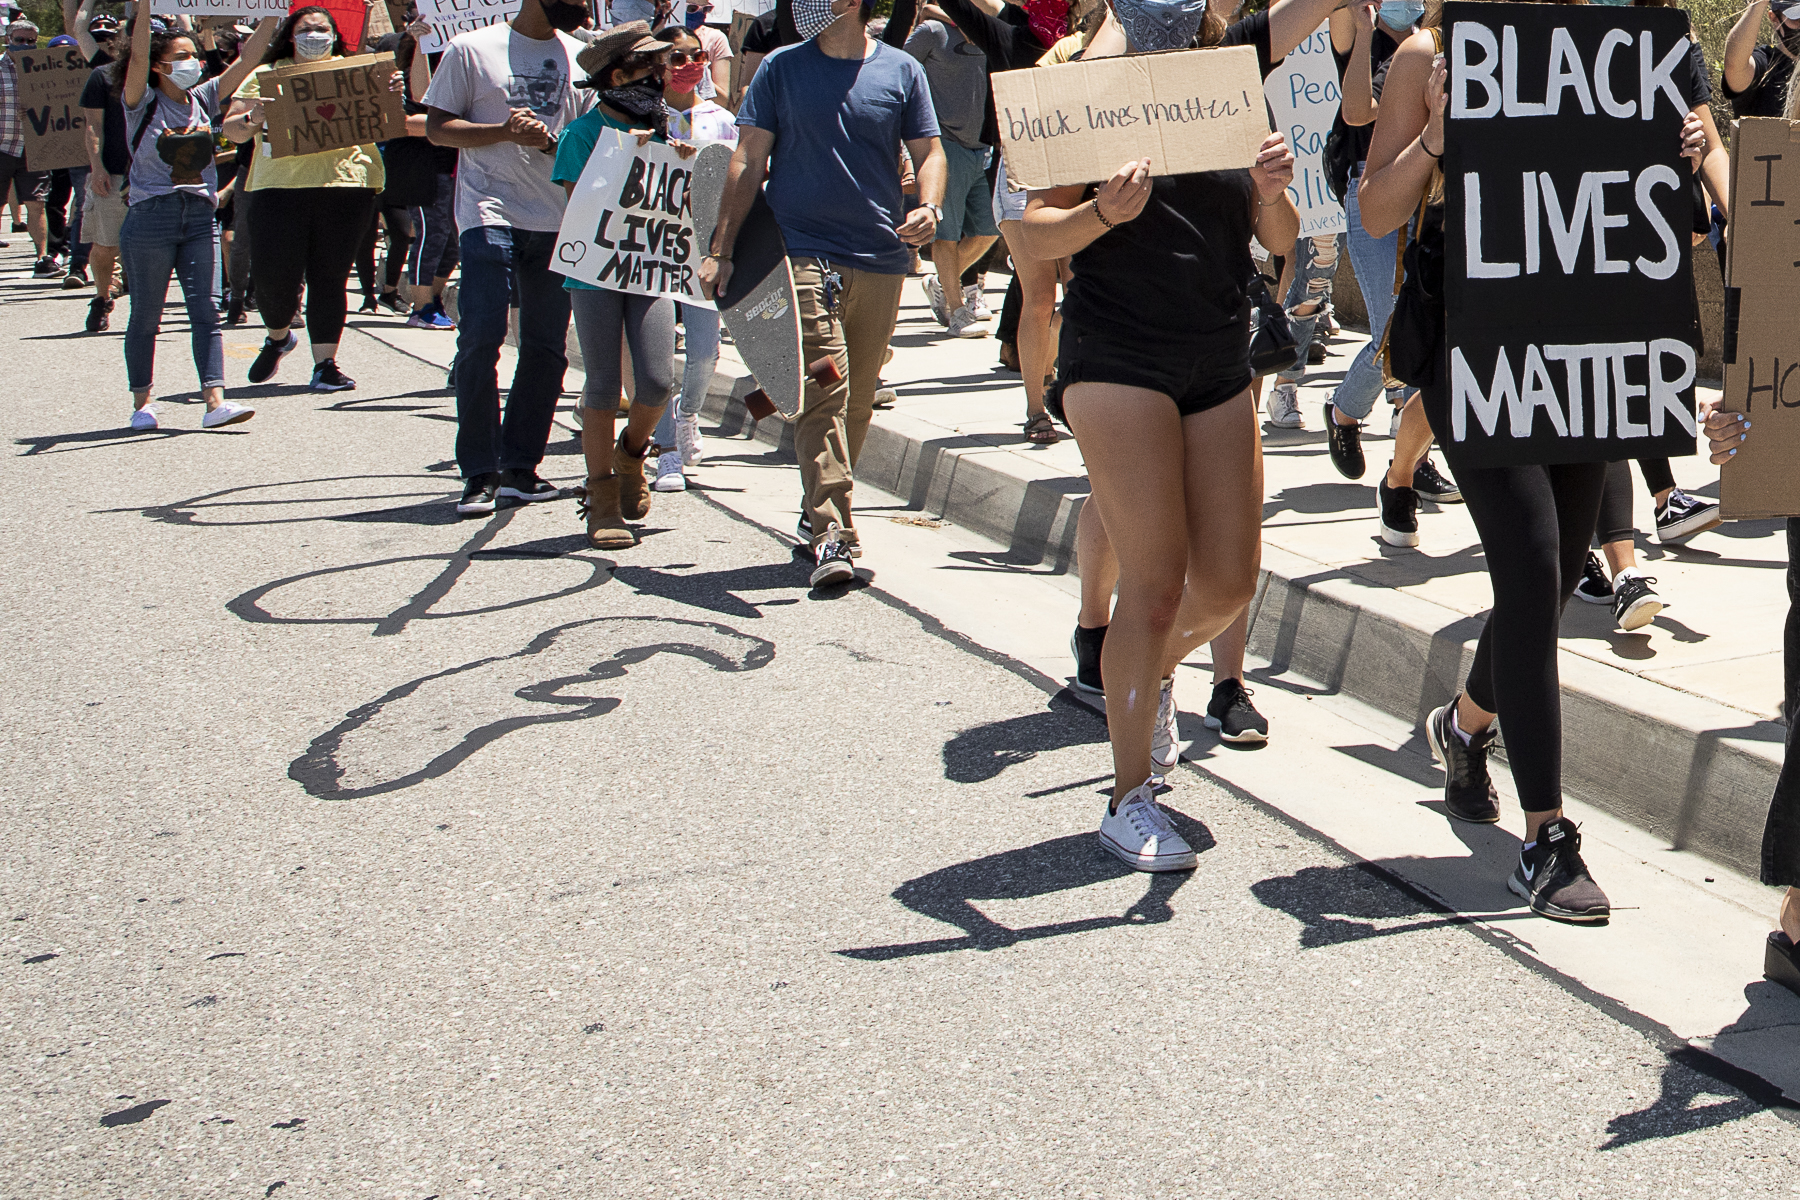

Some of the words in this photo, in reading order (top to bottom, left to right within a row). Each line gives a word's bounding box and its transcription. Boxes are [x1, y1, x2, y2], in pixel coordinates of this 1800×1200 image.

[291, 65, 382, 104] BLACK
[1450, 20, 1691, 122] BLACK
[293, 115, 385, 157] MATTER
[1006, 104, 1081, 142] black
[1086, 98, 1139, 131] lives
[619, 155, 693, 221] BLACK
[1753, 153, 1786, 208] I
[593, 208, 694, 264] LIVES
[1463, 163, 1681, 281] LIVES
[596, 250, 694, 296] MATTER
[1451, 337, 1698, 443] MATTER
